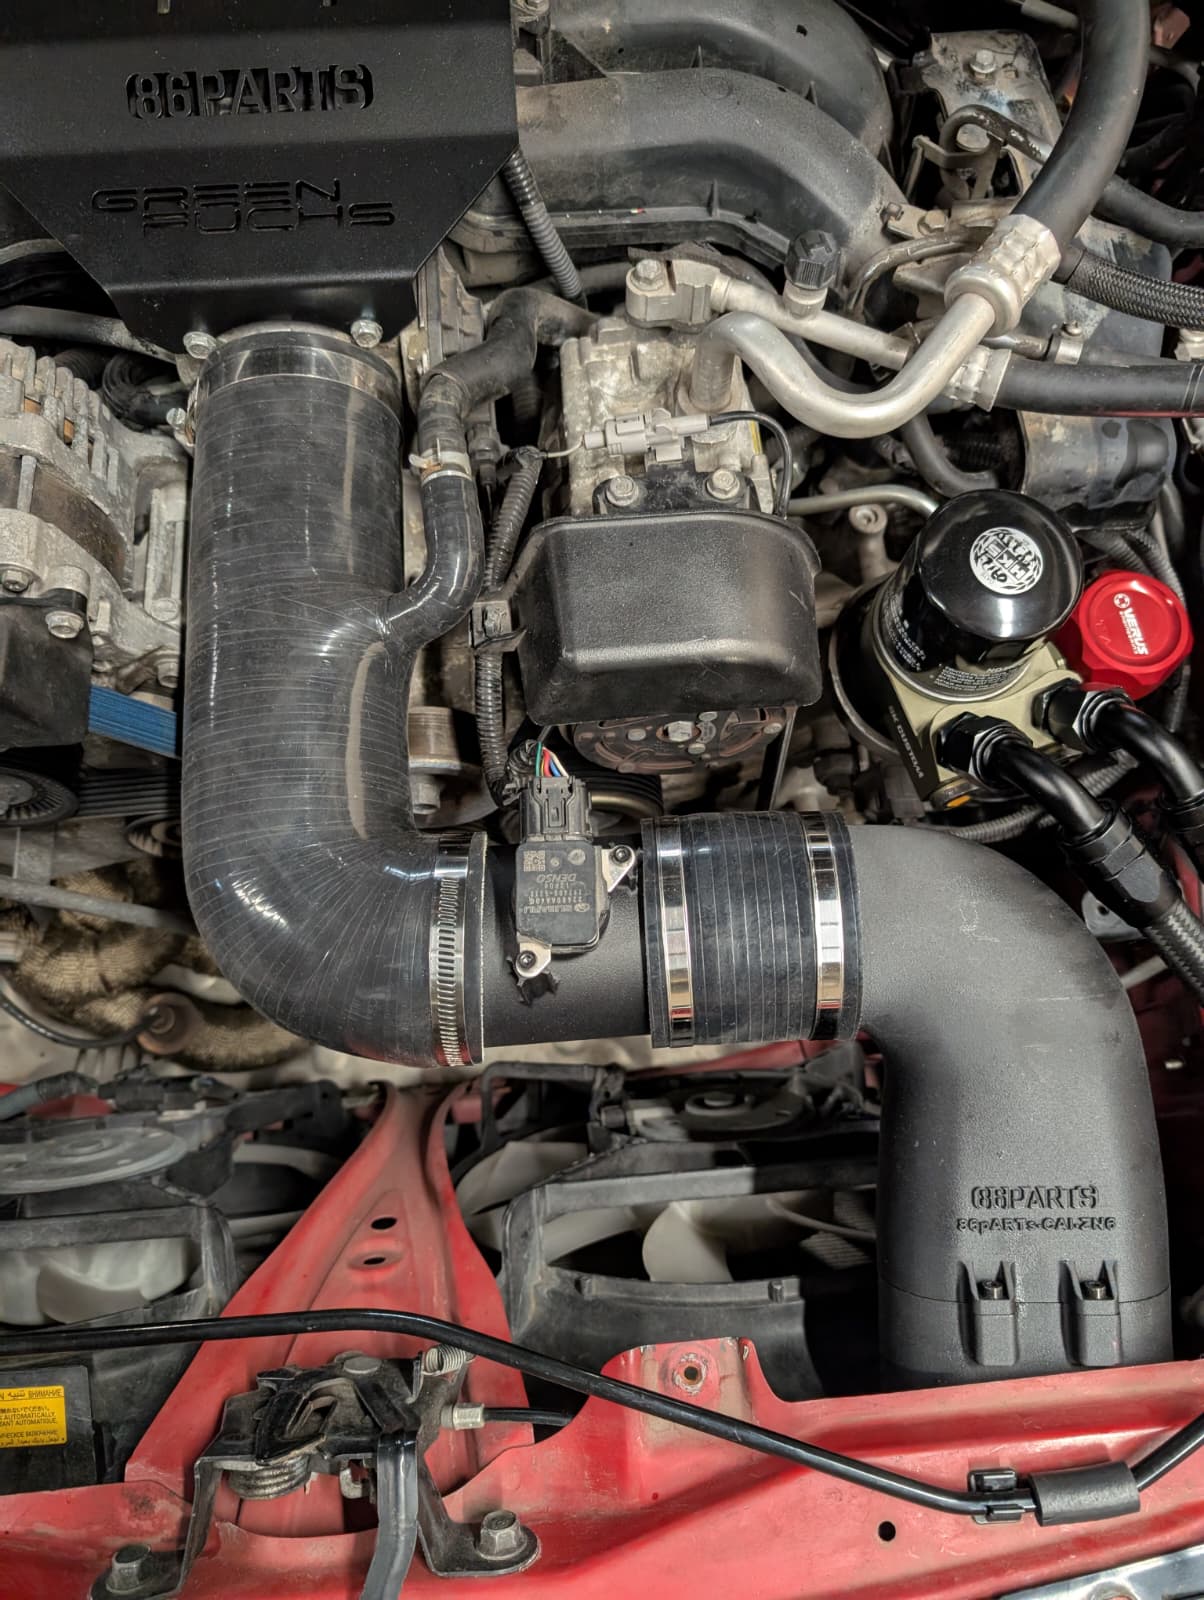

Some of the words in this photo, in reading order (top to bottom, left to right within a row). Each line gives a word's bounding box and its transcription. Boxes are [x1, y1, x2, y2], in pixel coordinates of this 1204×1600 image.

[127, 64, 372, 119] 86PARTS
[92, 178, 340, 212] GREEN
[143, 202, 395, 236] FUCHS
[985, 540, 1030, 580] HKS
[1124, 607, 1149, 655] VERUS
[536, 873, 577, 883] DENSO
[971, 1184, 1098, 1210] 86PARTS
